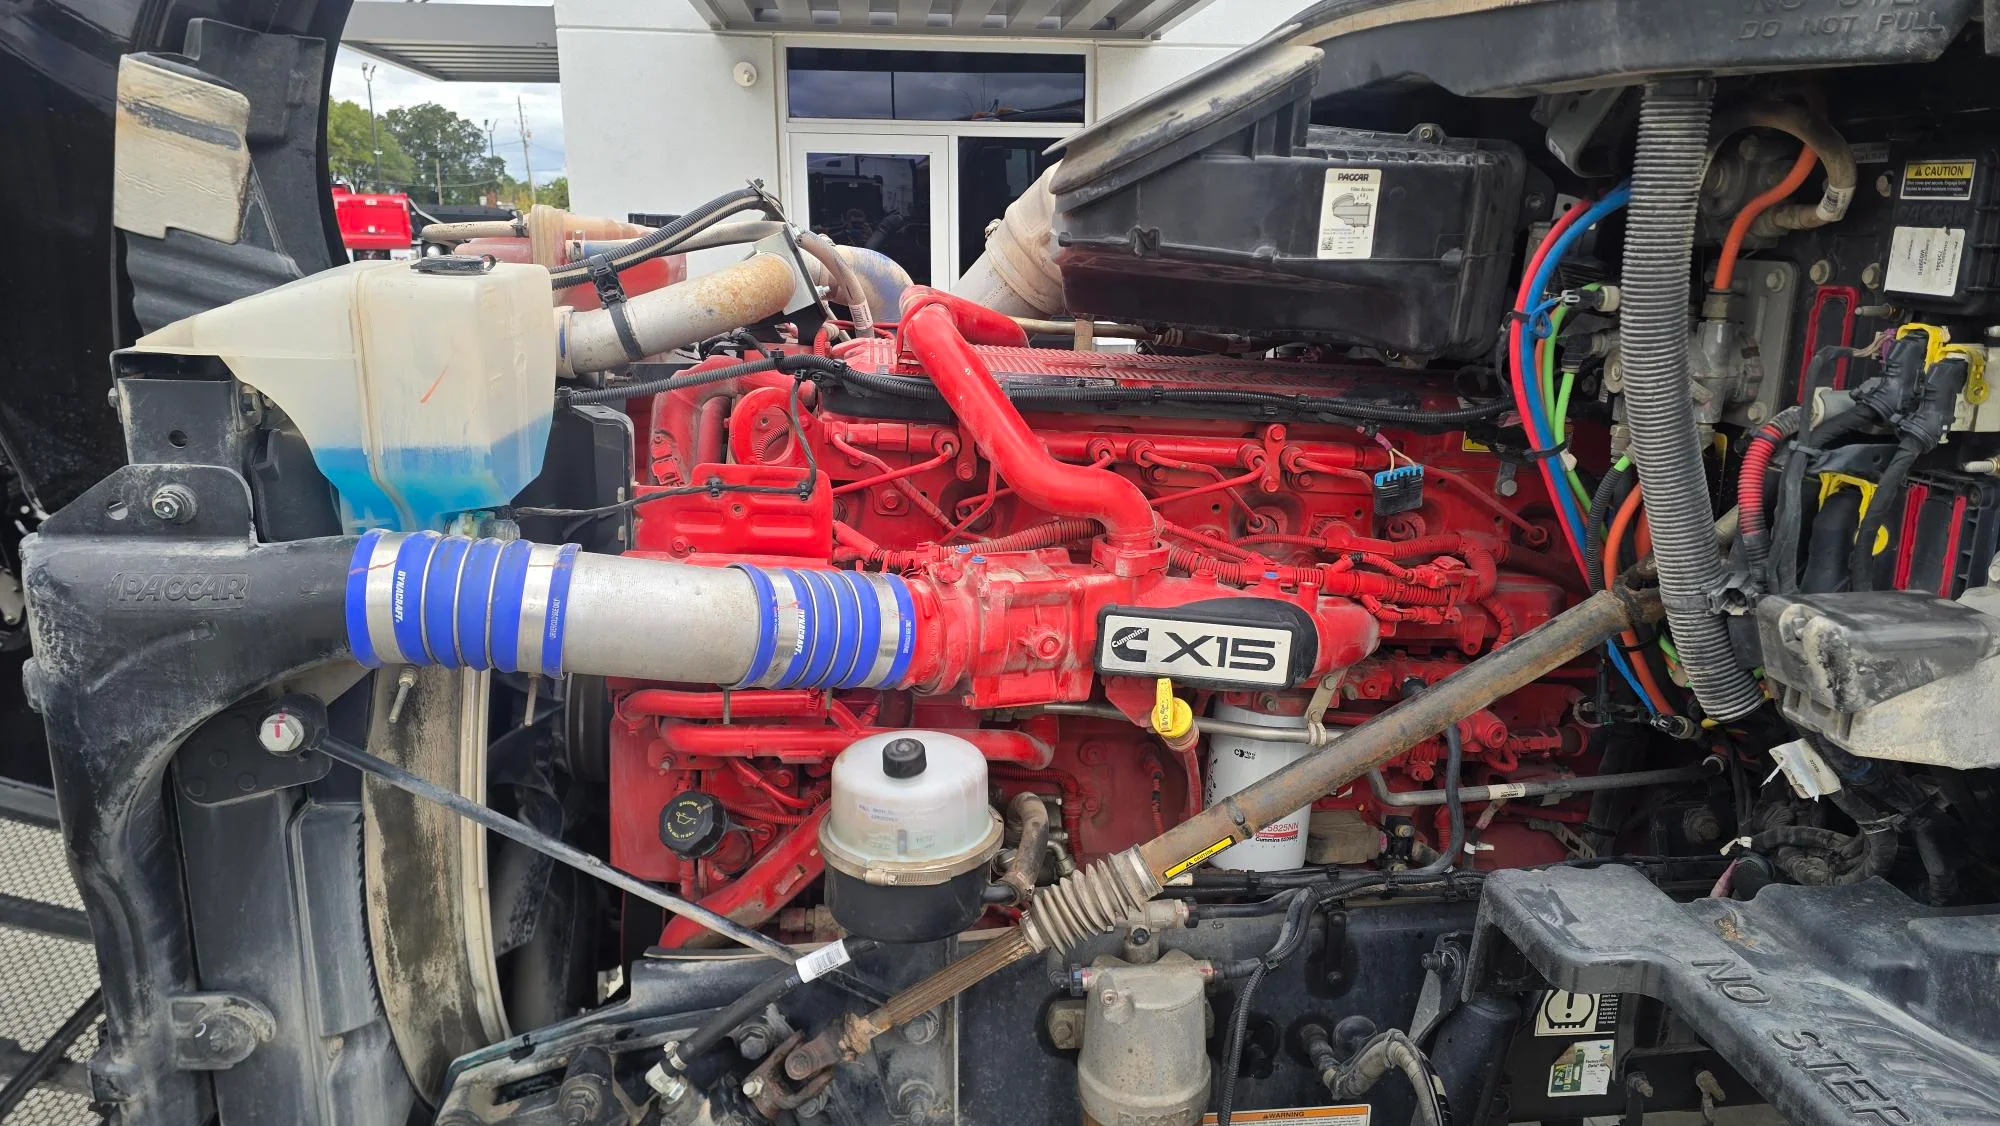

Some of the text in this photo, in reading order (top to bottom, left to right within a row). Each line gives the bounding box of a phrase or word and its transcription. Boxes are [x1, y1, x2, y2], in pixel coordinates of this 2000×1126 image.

[1738, 11, 1946, 40] DO NOT PULL
[1338, 172, 1369, 181] PACCAR
[1924, 165, 1964, 177] CAUTION
[118, 572, 248, 602] PACCAR
[394, 570, 407, 623] DYNACRAFT
[795, 608, 806, 655] DYNACRAFT
[1111, 626, 1147, 649] Cummins
[1160, 631, 1276, 672] X15
[1193, 848, 1214, 862] CAUTION
[1691, 958, 1774, 1005] NO
[1772, 1029, 1914, 1126] STEP
[1267, 1111, 1305, 1120] WARNING
